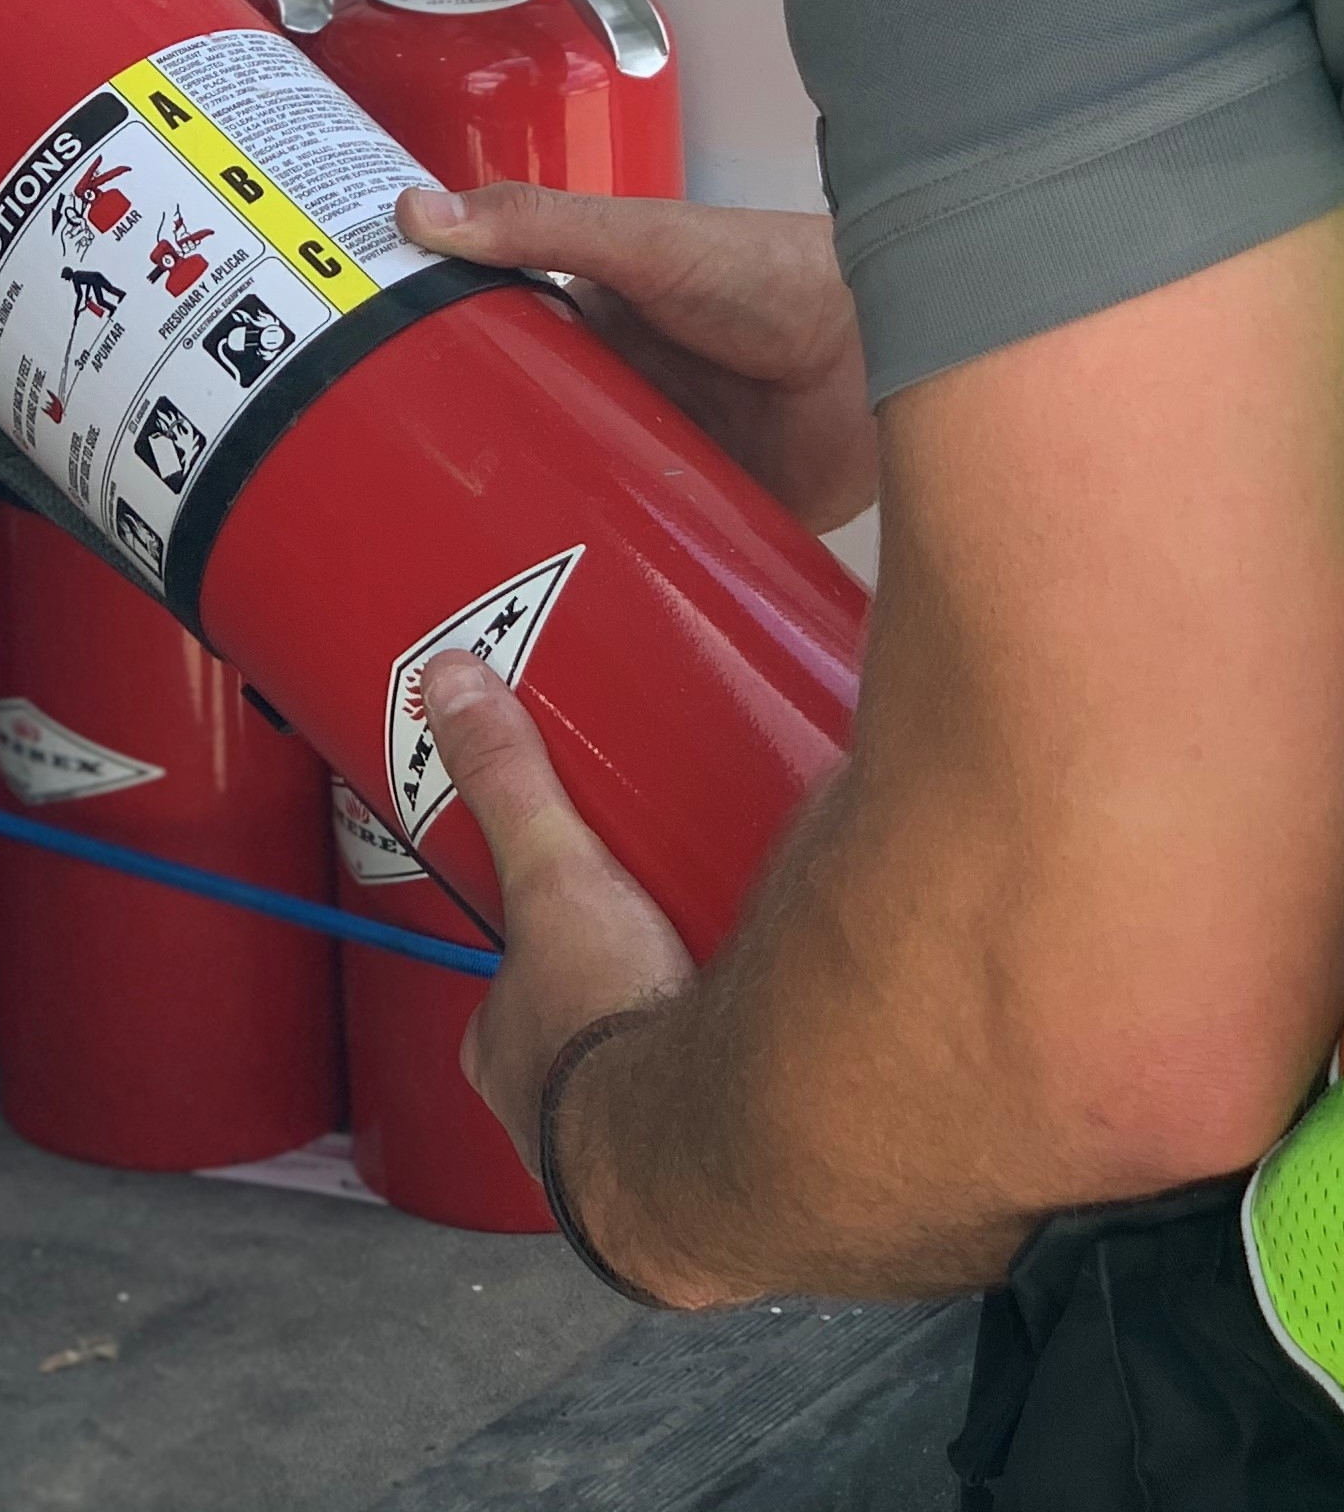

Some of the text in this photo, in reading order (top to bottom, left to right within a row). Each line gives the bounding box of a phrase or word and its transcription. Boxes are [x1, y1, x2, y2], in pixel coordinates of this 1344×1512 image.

[156, 40, 207, 64] MAINTENANCE:
[189, 89, 198, 97] IN
[148, 90, 192, 129] A
[211, 97, 255, 119] RECHARGE:
[224, 123, 237, 132] TO
[245, 144, 256, 152] BY
[268, 165, 280, 174] TO
[274, 163, 303, 180] TESTED
[281, 167, 318, 187] SUPPLIED
[220, 166, 264, 205] B
[304, 190, 341, 210] CAUTION:
[310, 196, 350, 217] SURFACES
[111, 208, 143, 243] JALAR
[337, 219, 383, 243] CONTENTS:
[352, 232, 398, 257] AMMONIUM
[299, 239, 343, 279] C
[5, 279, 24, 302] PIN.
[157, 247, 249, 340] PRESIONAR Y APLICAR
[190, 306, 223, 340] ELECTRICAL
[221, 276, 255, 309] EQUIPMENT
[90, 321, 126, 372] APUNTAR
[17, 354, 33, 380] FEET.
[73, 348, 91, 371] 3m
[30, 367, 46, 392] FIRE.
[28, 387, 39, 403] OF
[84, 423, 101, 449] SIDE.
[81, 444, 93, 461] TO
[403, 595, 529, 812] AMEX
